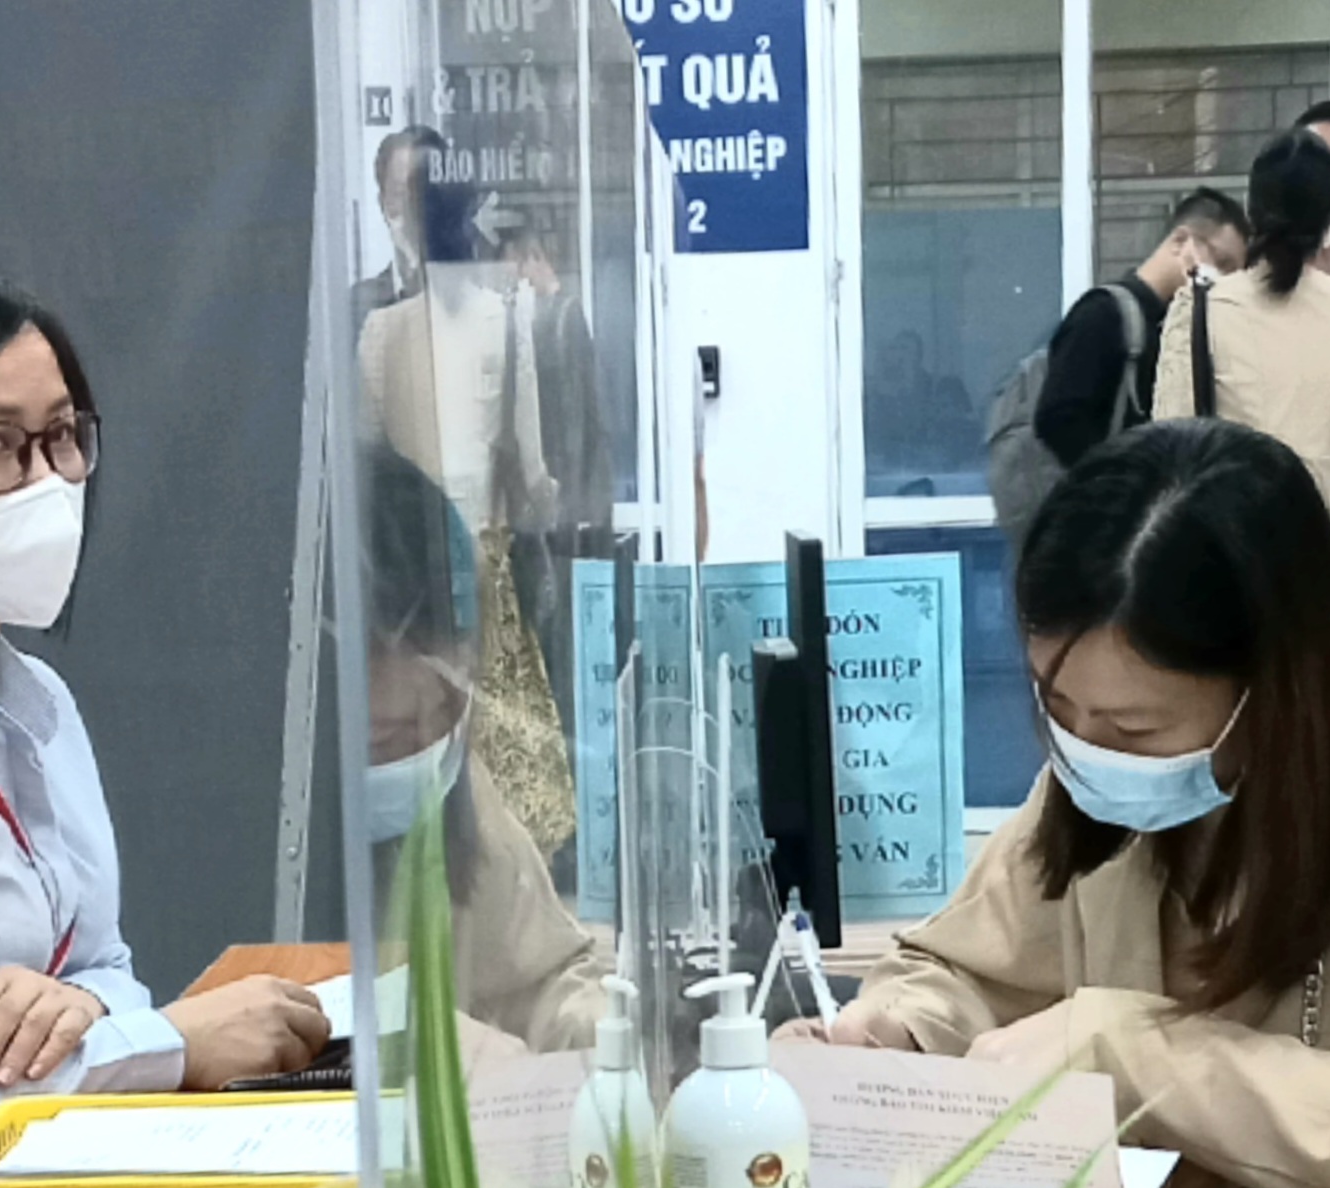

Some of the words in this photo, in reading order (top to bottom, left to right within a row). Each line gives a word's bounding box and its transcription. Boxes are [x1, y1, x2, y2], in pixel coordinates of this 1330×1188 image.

[682, 35, 780, 111] QUẢ
[670, 130, 787, 180] NGHIỆP
[687, 200, 707, 233] 2
[836, 702, 913, 728] ĐỘNG
[841, 748, 890, 769] GIA
[838, 792, 918, 820] DỤNG
